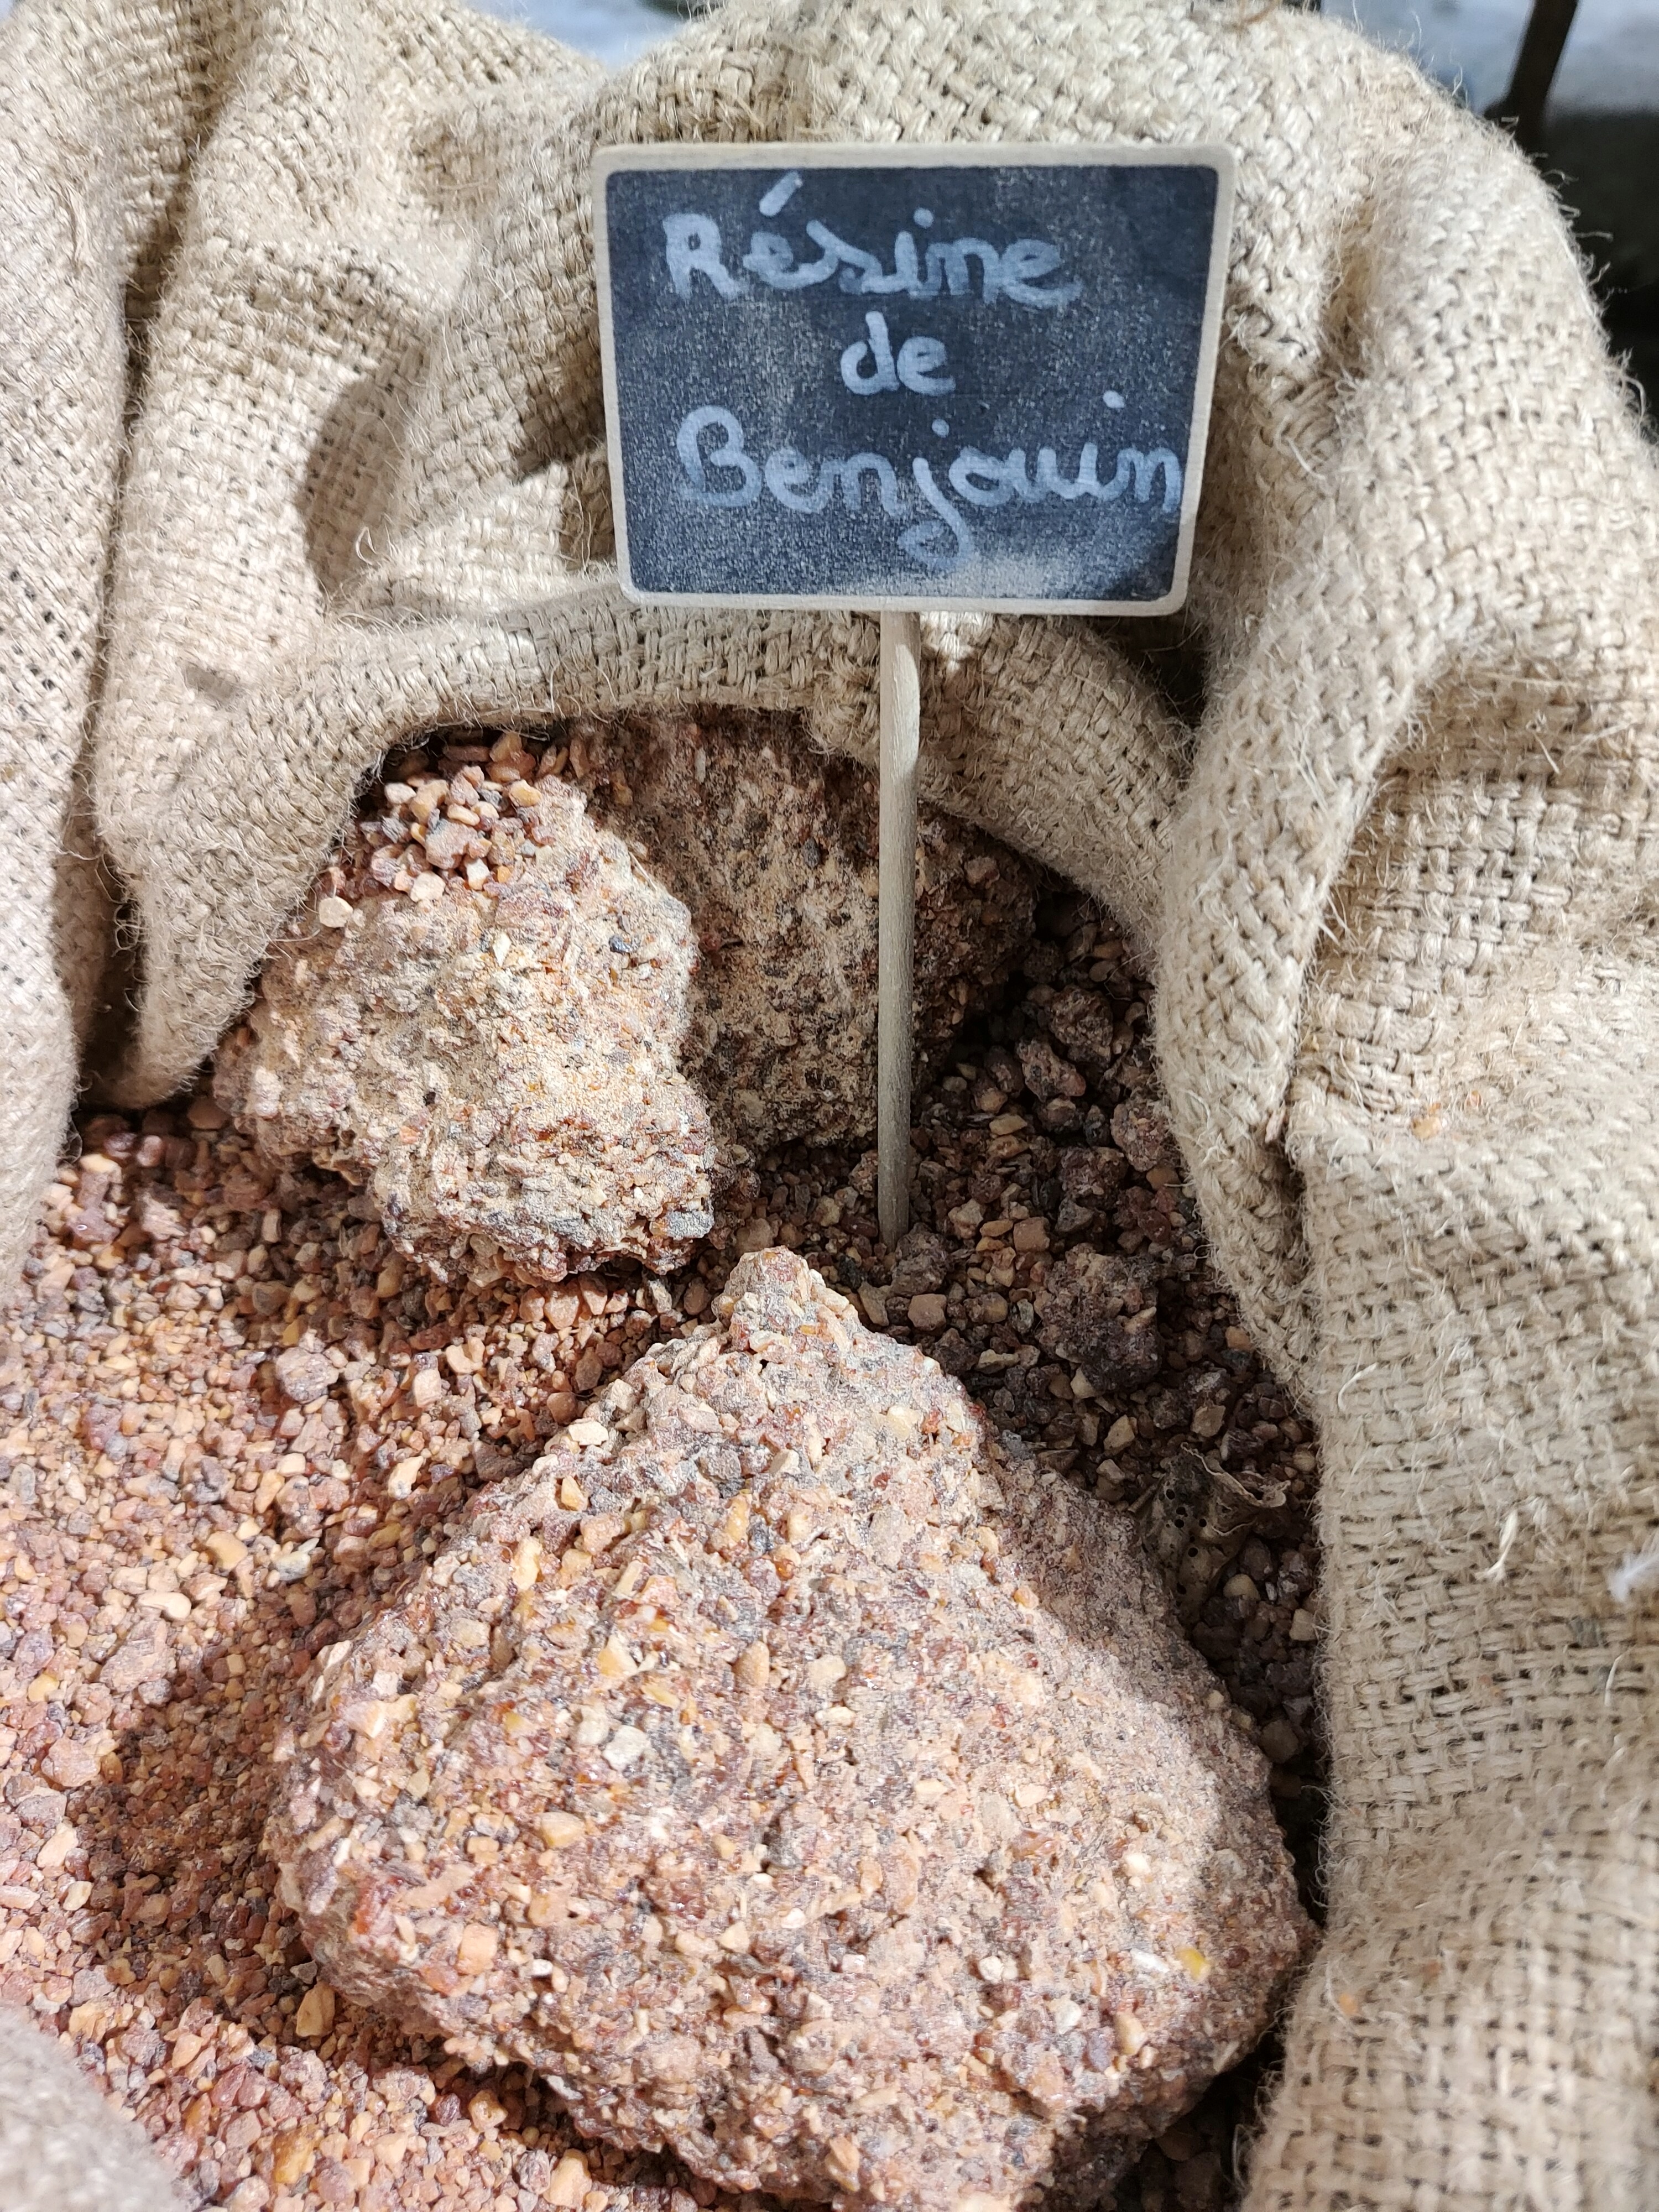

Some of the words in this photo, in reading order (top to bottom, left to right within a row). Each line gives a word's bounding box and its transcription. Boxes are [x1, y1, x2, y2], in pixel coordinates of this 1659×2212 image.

[664, 171, 1081, 305] Résine
[841, 311, 954, 394] de
[676, 390, 1182, 571] Benjouin
